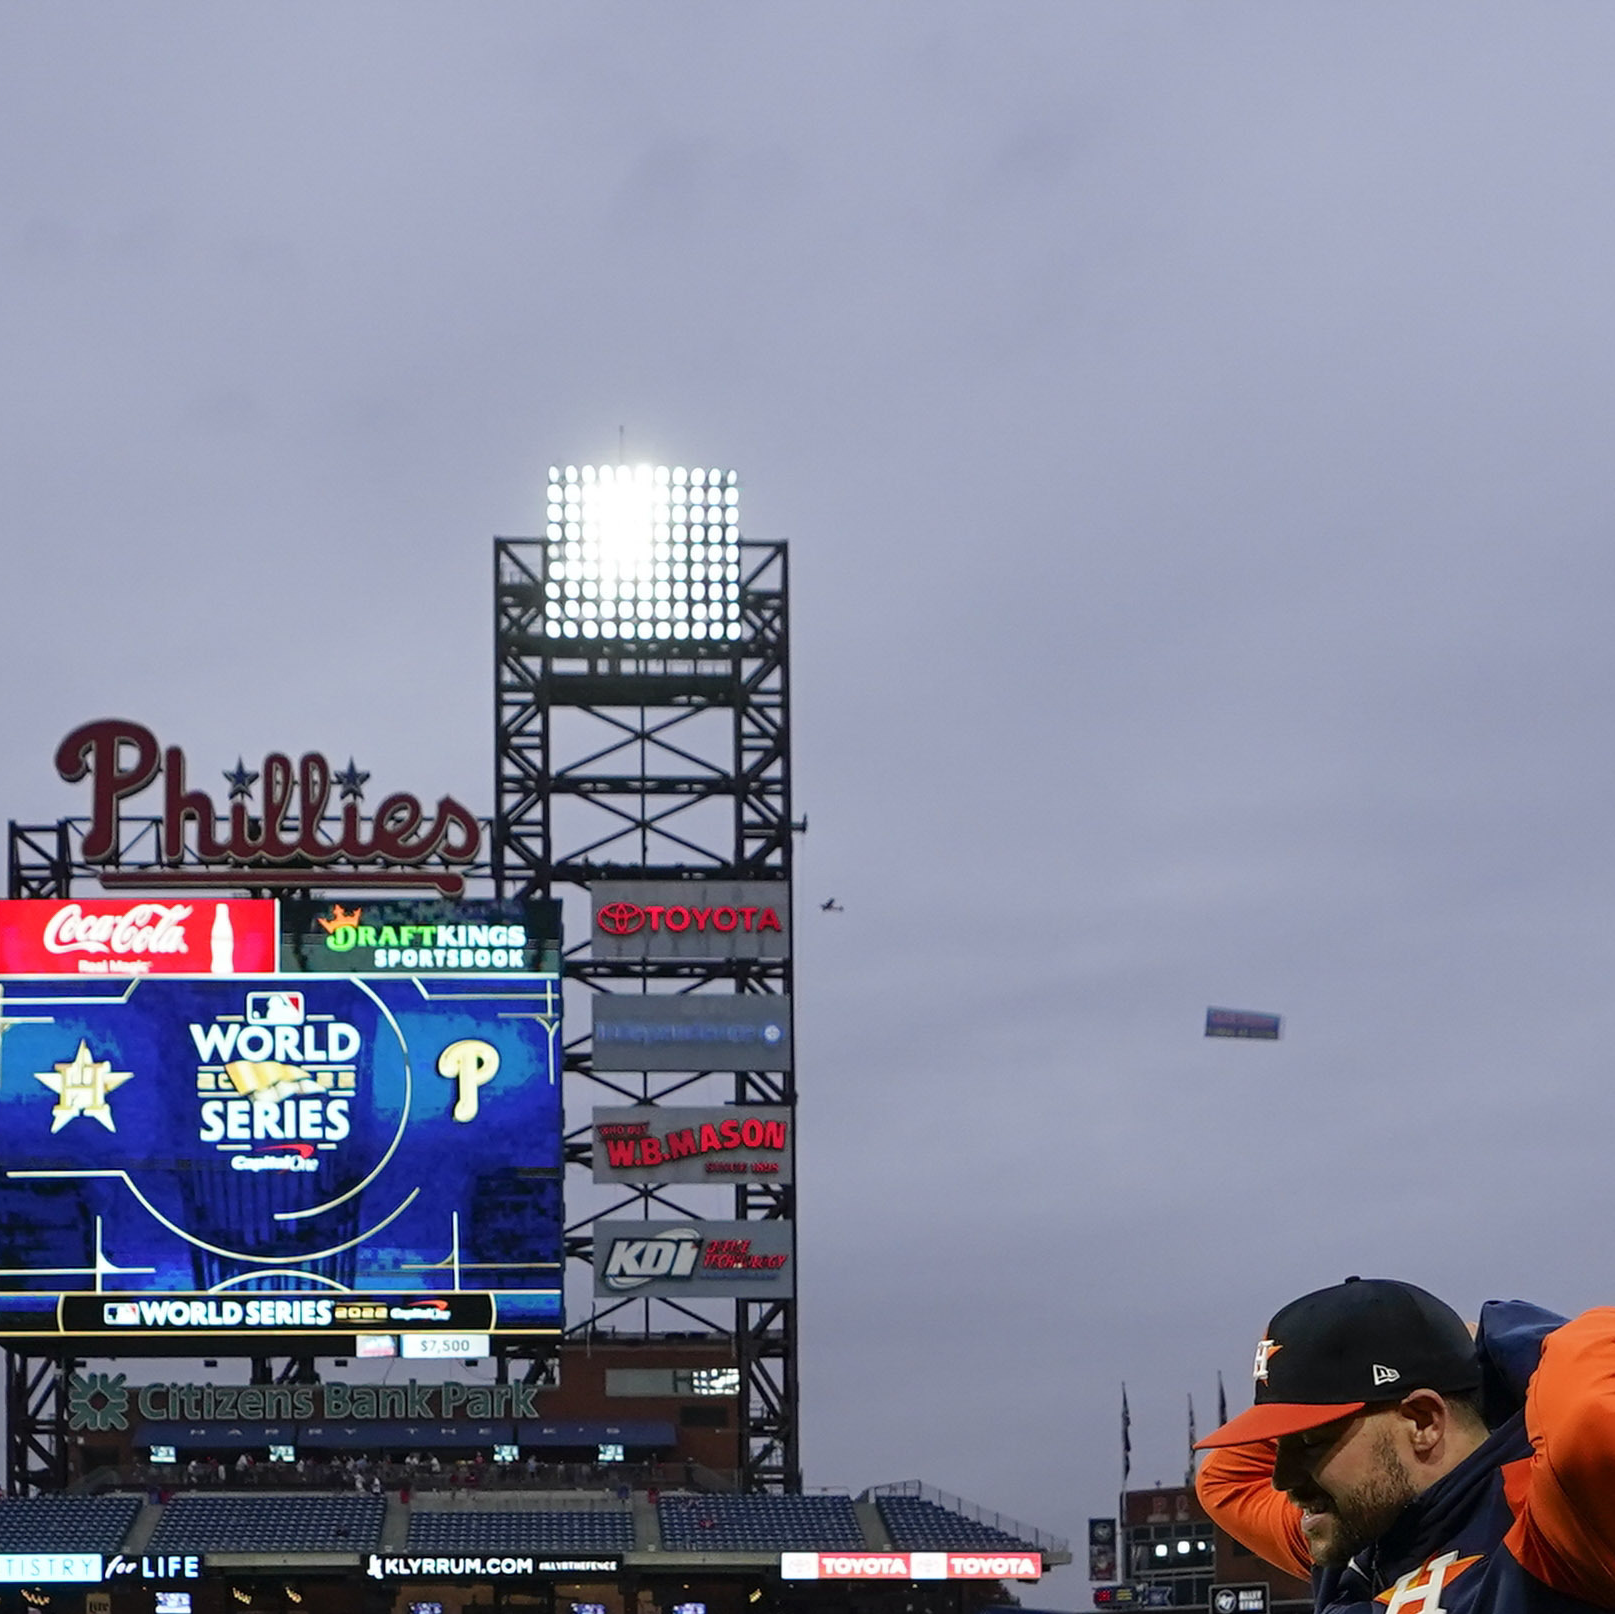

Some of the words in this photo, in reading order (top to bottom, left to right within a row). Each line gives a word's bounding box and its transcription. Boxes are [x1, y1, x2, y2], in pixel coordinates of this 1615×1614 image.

[54, 719, 482, 864] Phillies
[643, 903, 782, 934] TOYOTA
[326, 923, 526, 951] DRAFTKINGS
[374, 949, 524, 968] SPORTSBOOK
[189, 1022, 361, 1063] WORLD
[199, 1099, 350, 1142] SERIES
[139, 1300, 244, 1326] WORLD
[245, 1300, 333, 1326] SERIES
[335, 1306, 387, 1319] 2022
[420, 1338, 470, 1354] $7,500
[137, 1382, 314, 1420] Citizens
[324, 1380, 434, 1420] Bank
[441, 1379, 539, 1420] Park
[105, 1555, 137, 1579] for
[141, 1556, 199, 1578] LIFE
[385, 1557, 533, 1575] KLYRRUM.COM
[822, 1557, 907, 1575] TOYOTA
[951, 1557, 1035, 1575] TOYOTA
